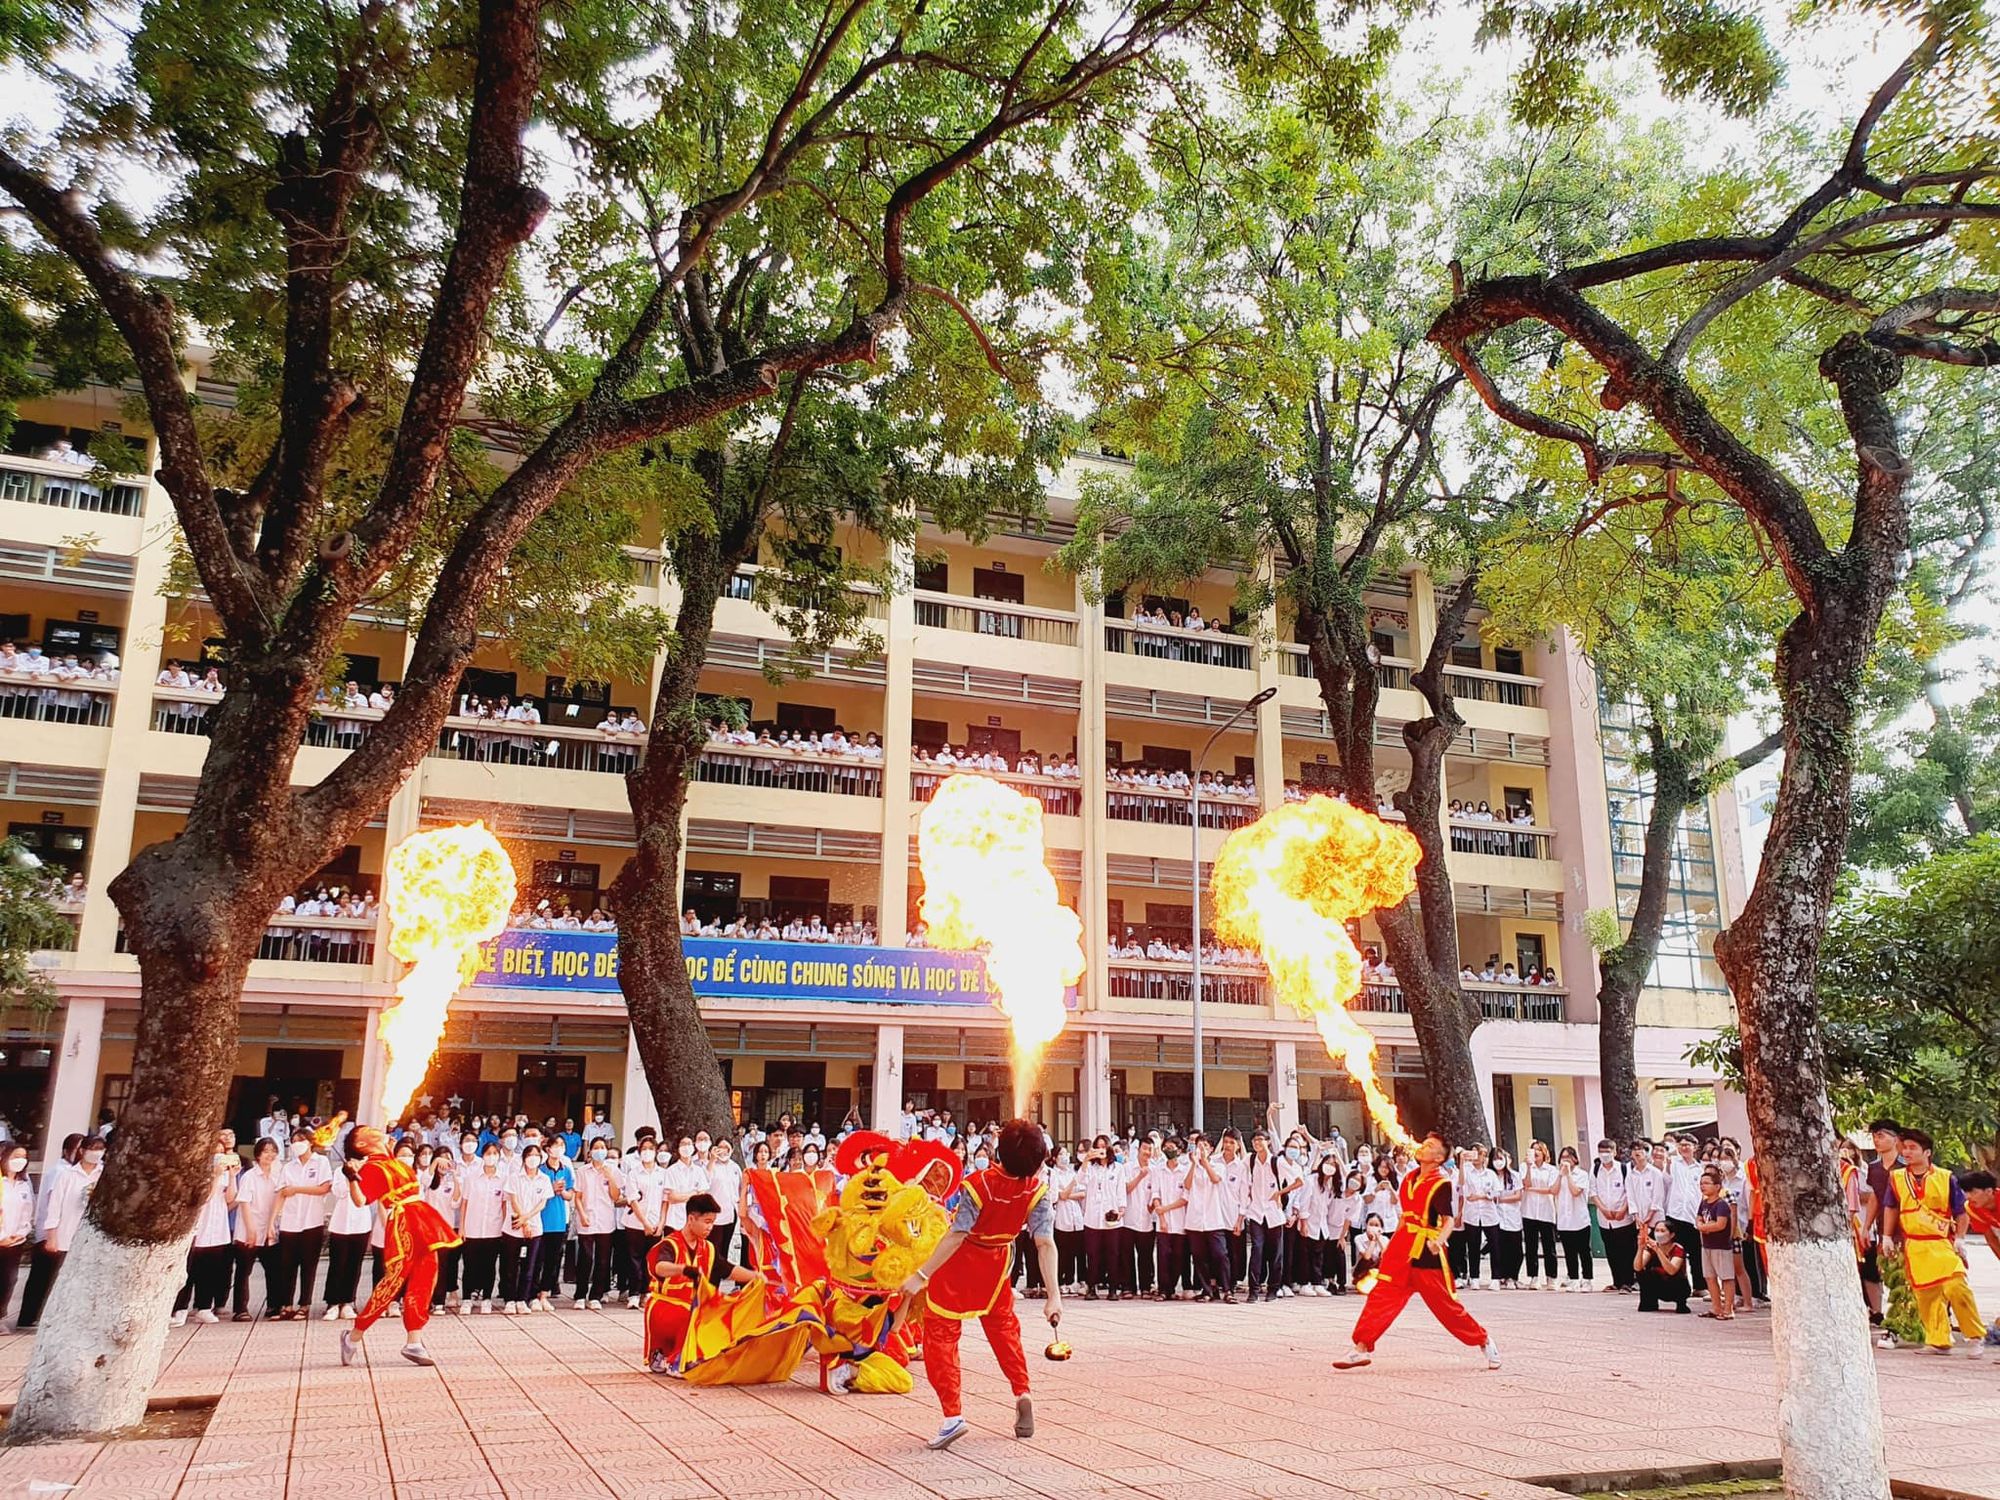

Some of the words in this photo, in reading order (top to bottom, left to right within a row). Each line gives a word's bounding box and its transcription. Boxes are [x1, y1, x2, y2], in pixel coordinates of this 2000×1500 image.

[502, 941, 546, 979] BIẾT,
[551, 950, 590, 982] HỌC
[712, 948, 738, 983] ĐỂ
[740, 954, 787, 985] CÙNG
[791, 961, 848, 987] CHUNG
[852, 956, 896, 989] SỐNG
[900, 961, 920, 990] VÀ
[924, 967, 956, 996] HỌC
